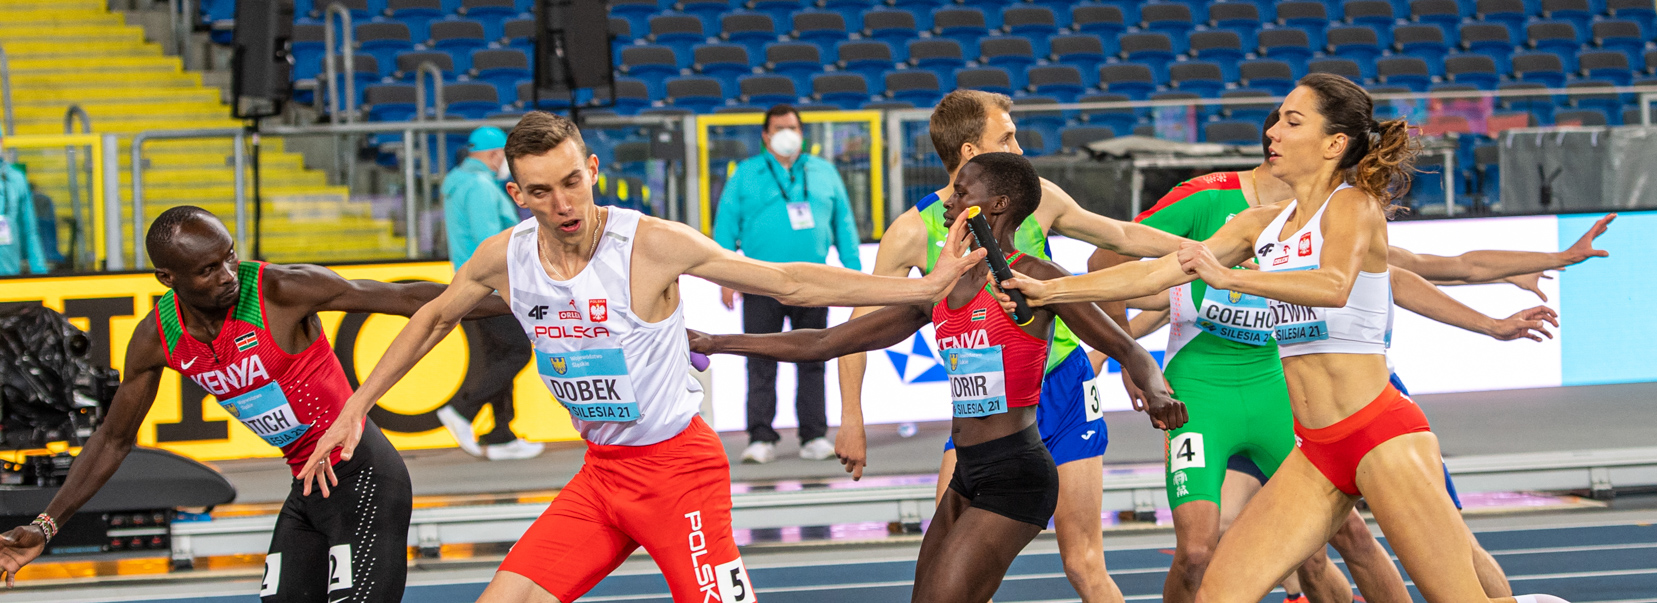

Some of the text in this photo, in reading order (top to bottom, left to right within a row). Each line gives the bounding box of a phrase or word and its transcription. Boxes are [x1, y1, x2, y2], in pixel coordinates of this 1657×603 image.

[528, 305, 549, 320] 4F
[534, 325, 610, 339] POLSKA
[1220, 327, 1261, 342] SILESIA
[1275, 325, 1321, 341] SILESIA 21
[190, 354, 270, 396] KENYA
[550, 379, 621, 401] DOBEK
[1090, 385, 1100, 414] 3
[571, 406, 630, 418] SILESIA 21
[957, 400, 1000, 415] SILESIA 21
[1176, 437, 1196, 462] 4
[329, 554, 340, 586] 2
[729, 566, 746, 602] 5
